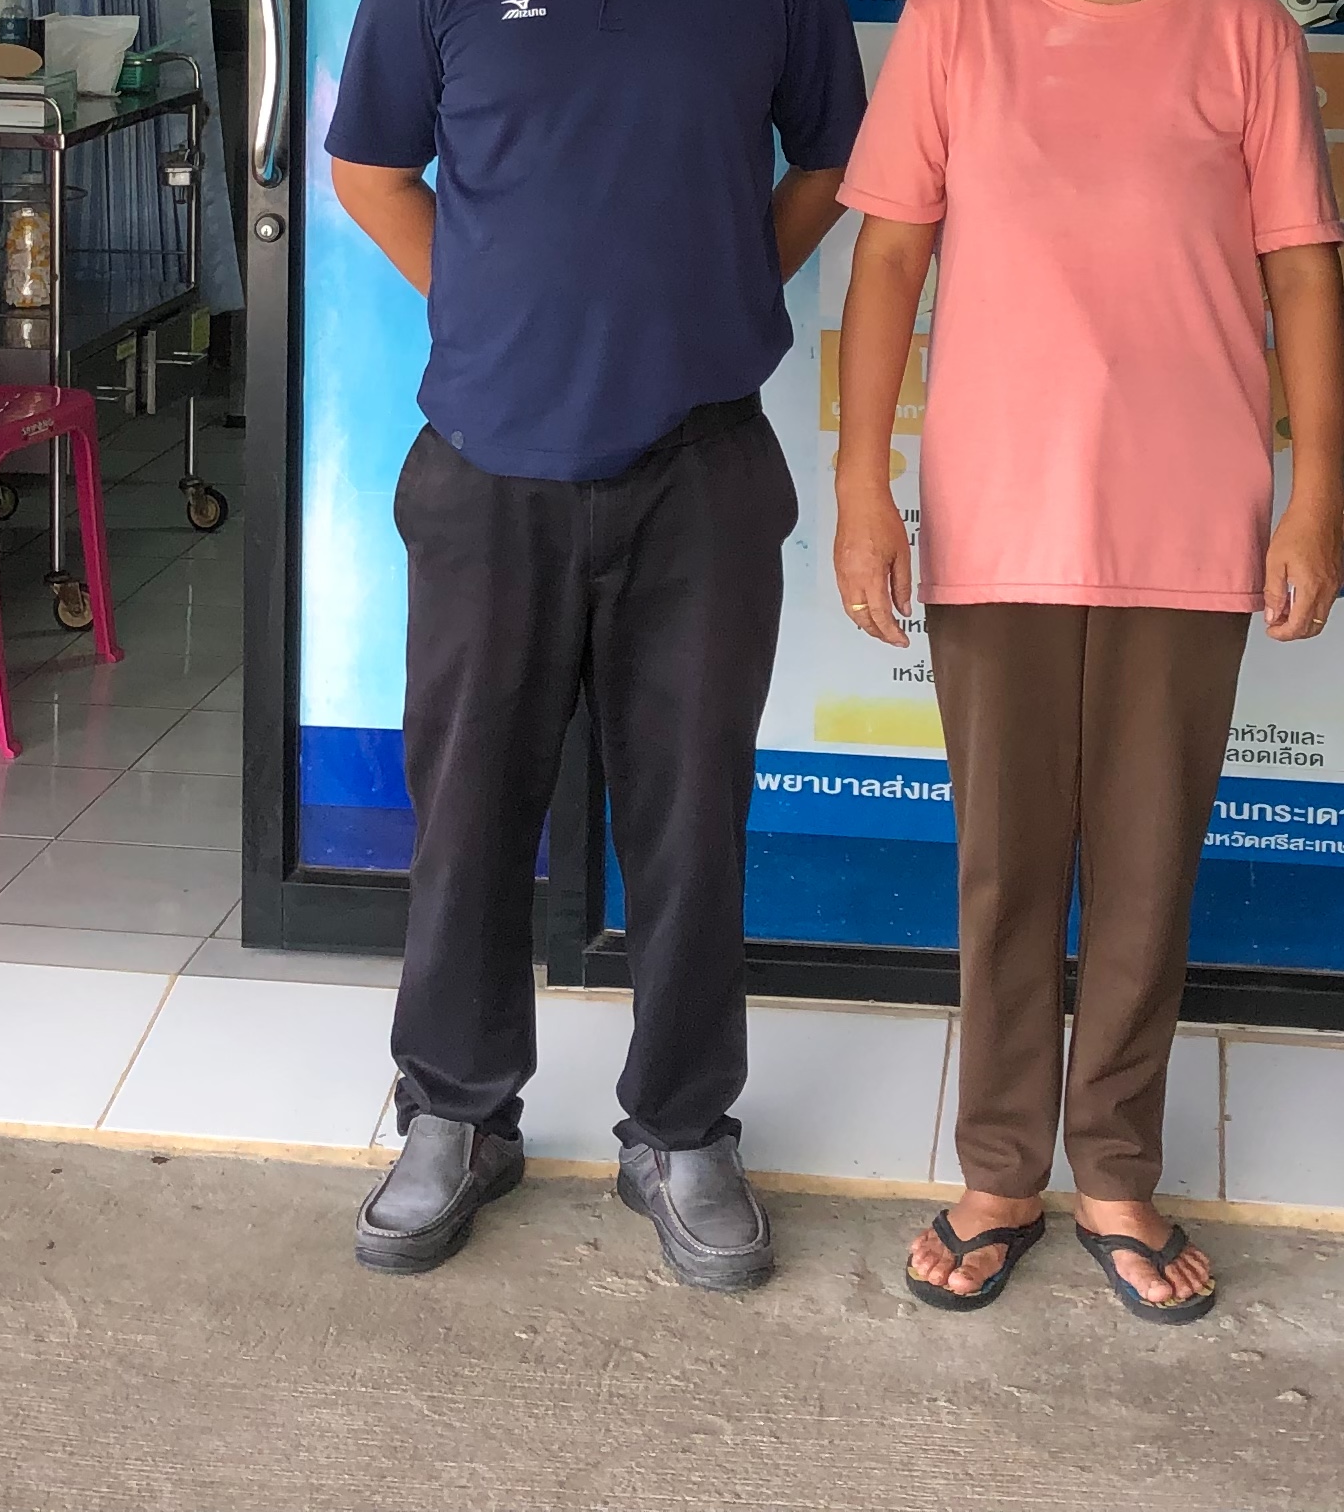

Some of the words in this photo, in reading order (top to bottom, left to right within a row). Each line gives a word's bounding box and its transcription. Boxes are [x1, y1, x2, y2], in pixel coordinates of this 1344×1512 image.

[1228, 723, 1326, 747] คหัวใจและ
[1225, 746, 1325, 768] ลอดเลือด
[756, 771, 954, 802] พยาบาลส่งเส
